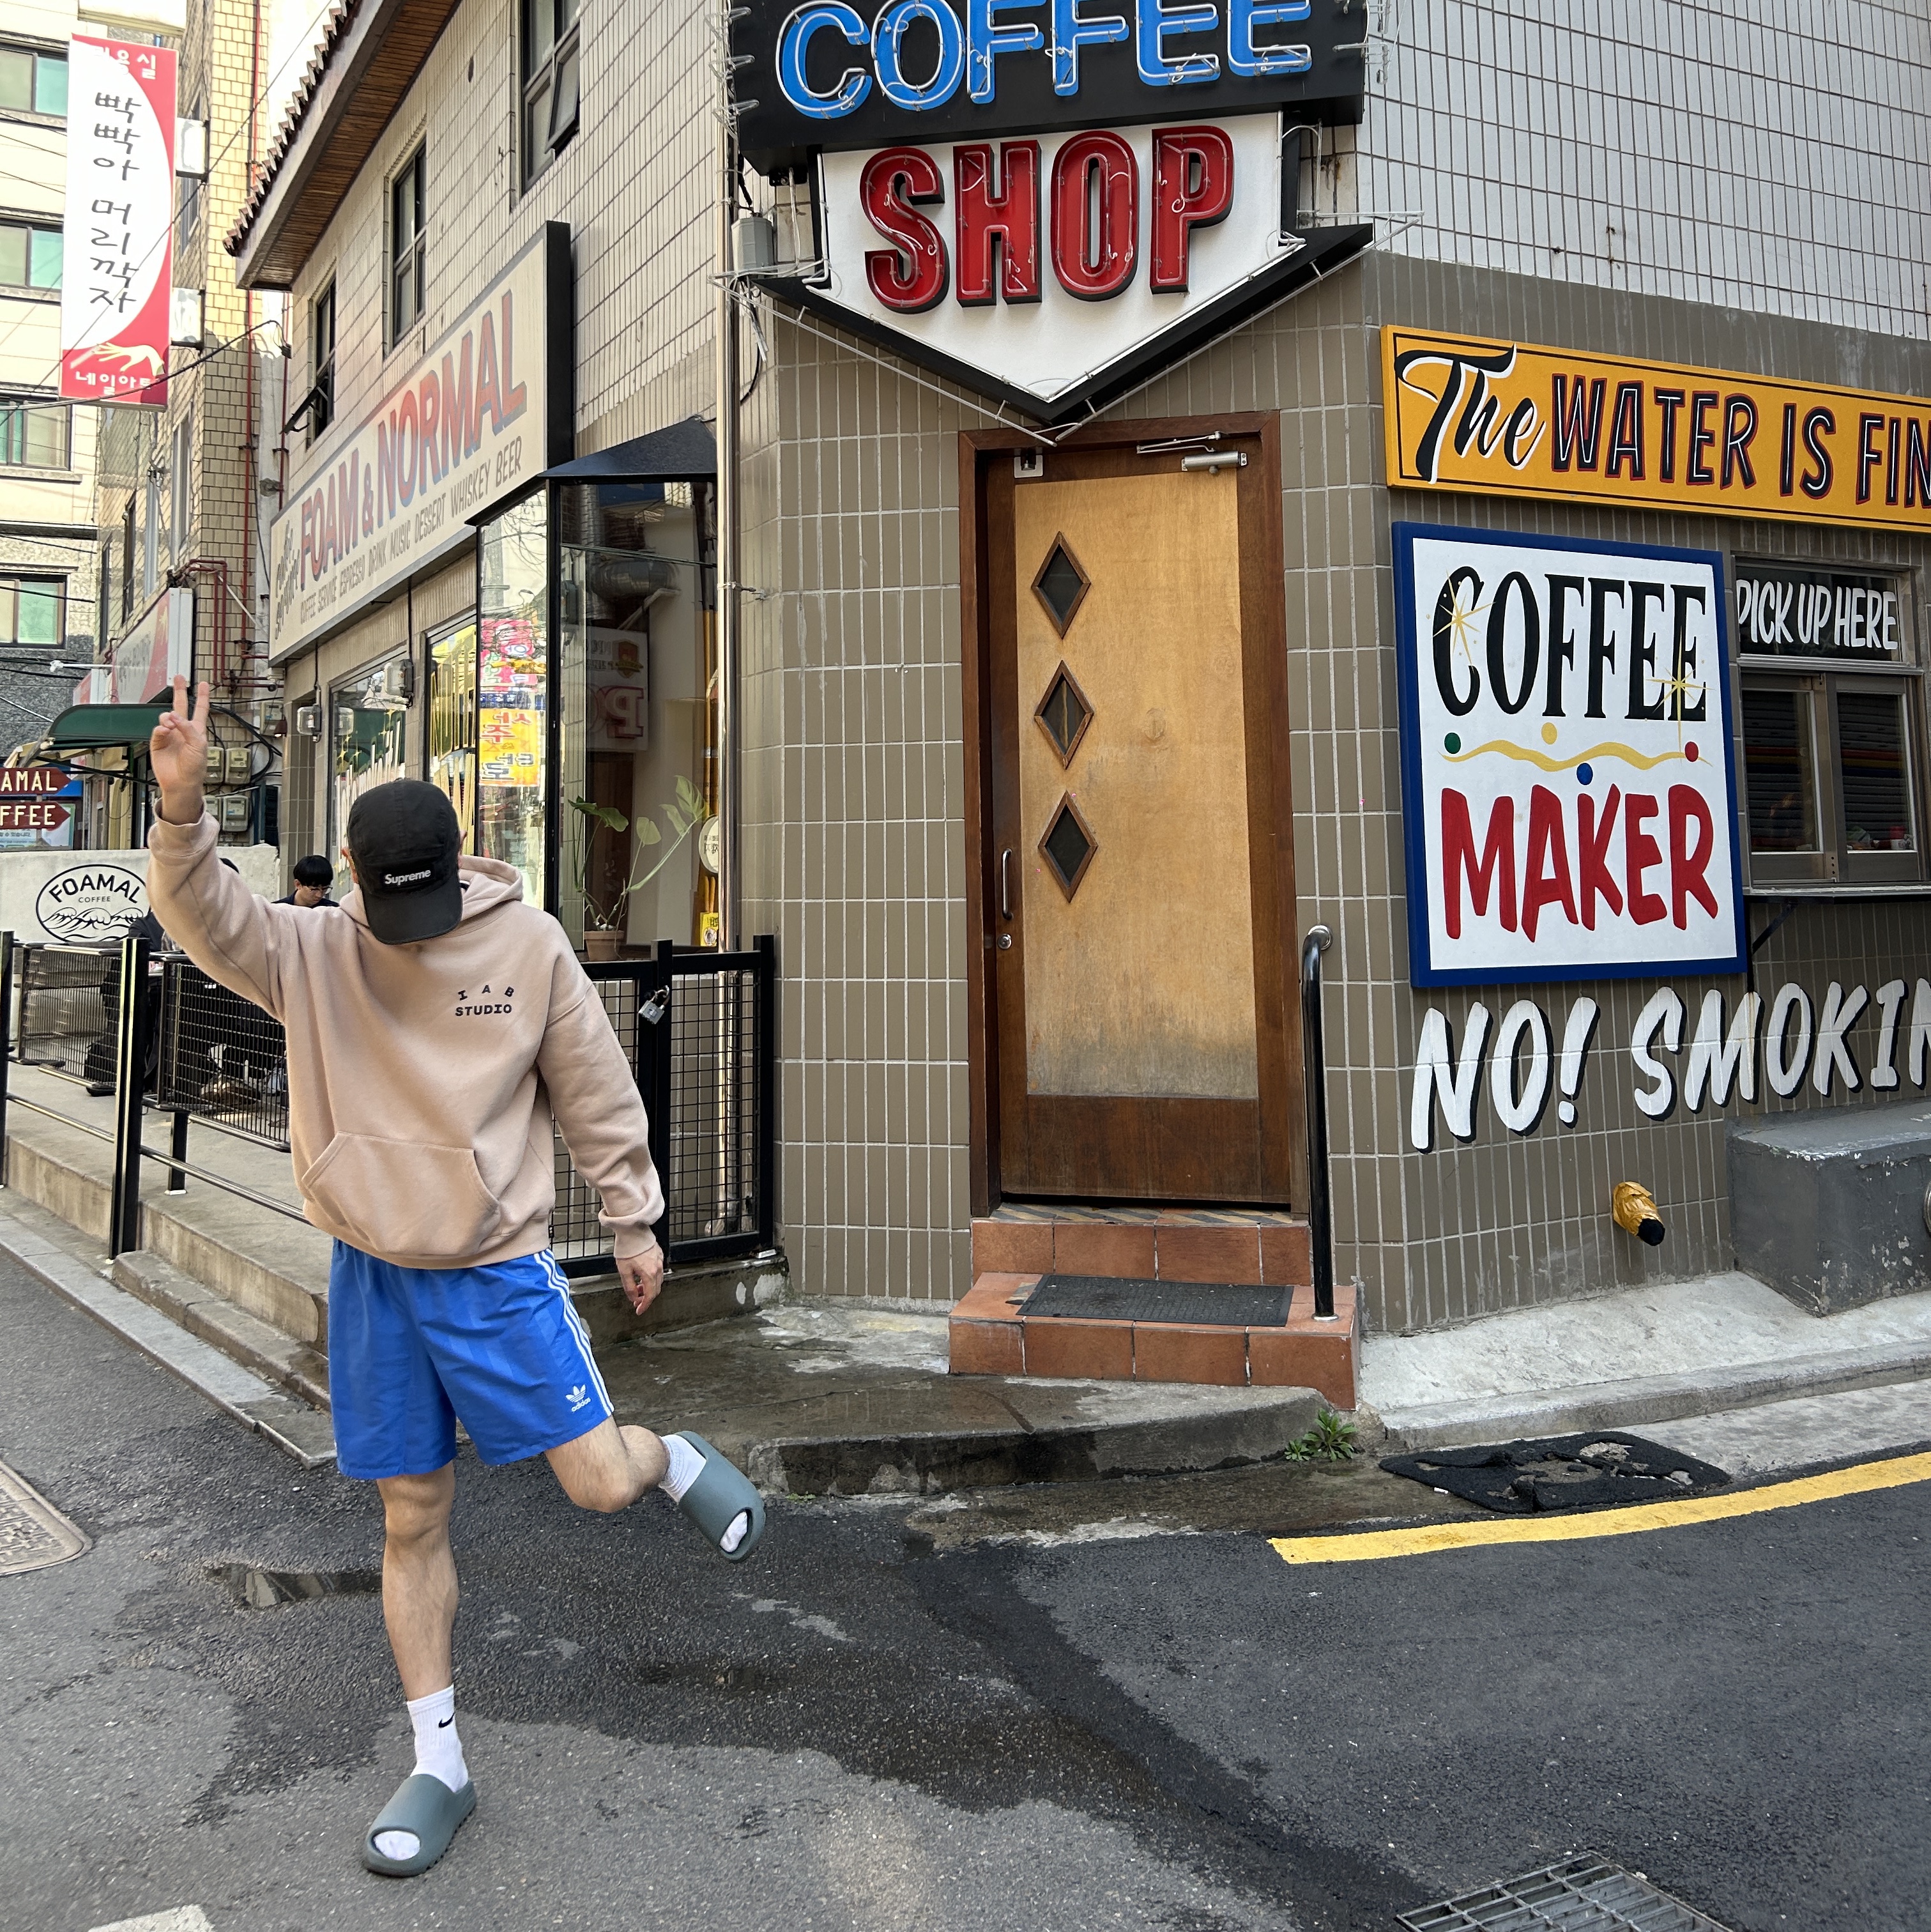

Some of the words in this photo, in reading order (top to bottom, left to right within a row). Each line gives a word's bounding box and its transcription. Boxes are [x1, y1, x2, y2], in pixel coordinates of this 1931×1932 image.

[775, 0, 1313, 118] COFFEE
[93, 92, 142, 181] 빡빡아
[860, 125, 1234, 314] SHOP
[75, 371, 152, 395] 네일아트
[1394, 342, 1546, 486] The
[1552, 373, 1759, 490] WATER
[1779, 404, 1836, 498] IS
[1856, 412, 1931, 509] FIN
[300, 447, 359, 592] FOAM
[362, 463, 375, 538] &
[378, 289, 528, 528] NORMAL
[369, 538, 387, 578] DRINK
[390, 519, 411, 562] MUSIC
[415, 492, 446, 544] DESSERT
[450, 458, 491, 518] WHISKEY
[496, 435, 523, 488] BEER
[1433, 565, 1707, 722] COFFEE
[1736, 579, 1794, 644] PICK
[1797, 583, 1832, 645] UP
[1834, 586, 1898, 650] HERE
[0, 770, 58, 792] AMAL
[49, 873, 140, 904] FOAMAL
[385, 870, 431, 886] Supreme
[1441, 783, 1719, 943] MAKER
[455, 1004, 512, 1016] STUDIO
[1410, 996, 1598, 1151] NO!
[571, 1397, 592, 1413] adidas
